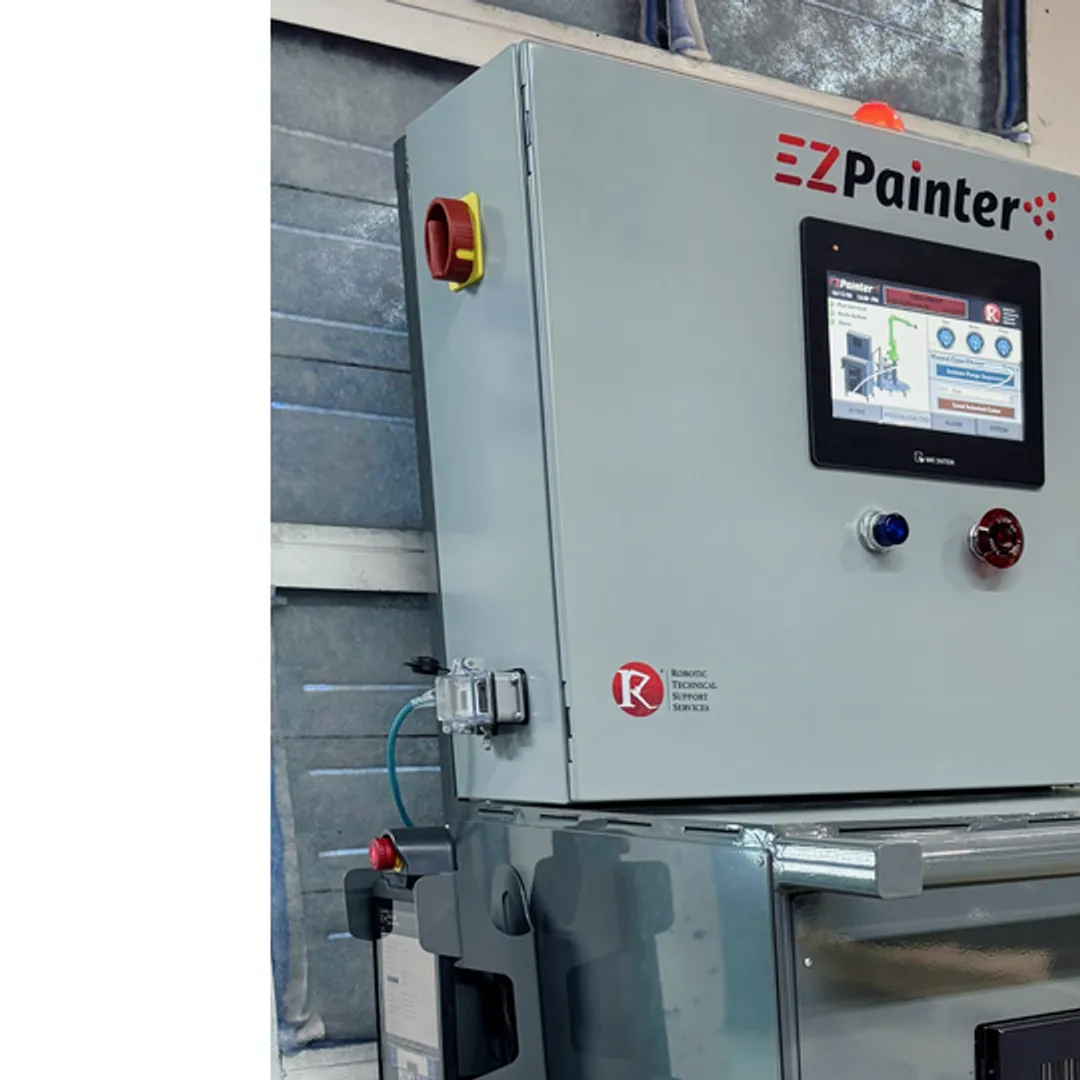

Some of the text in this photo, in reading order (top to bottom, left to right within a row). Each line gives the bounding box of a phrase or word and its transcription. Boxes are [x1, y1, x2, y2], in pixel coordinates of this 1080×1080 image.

[671, 680, 717, 689] TECHNICAL
[672, 692, 708, 701] SUPPORT
[672, 703, 710, 712] SERVICES
